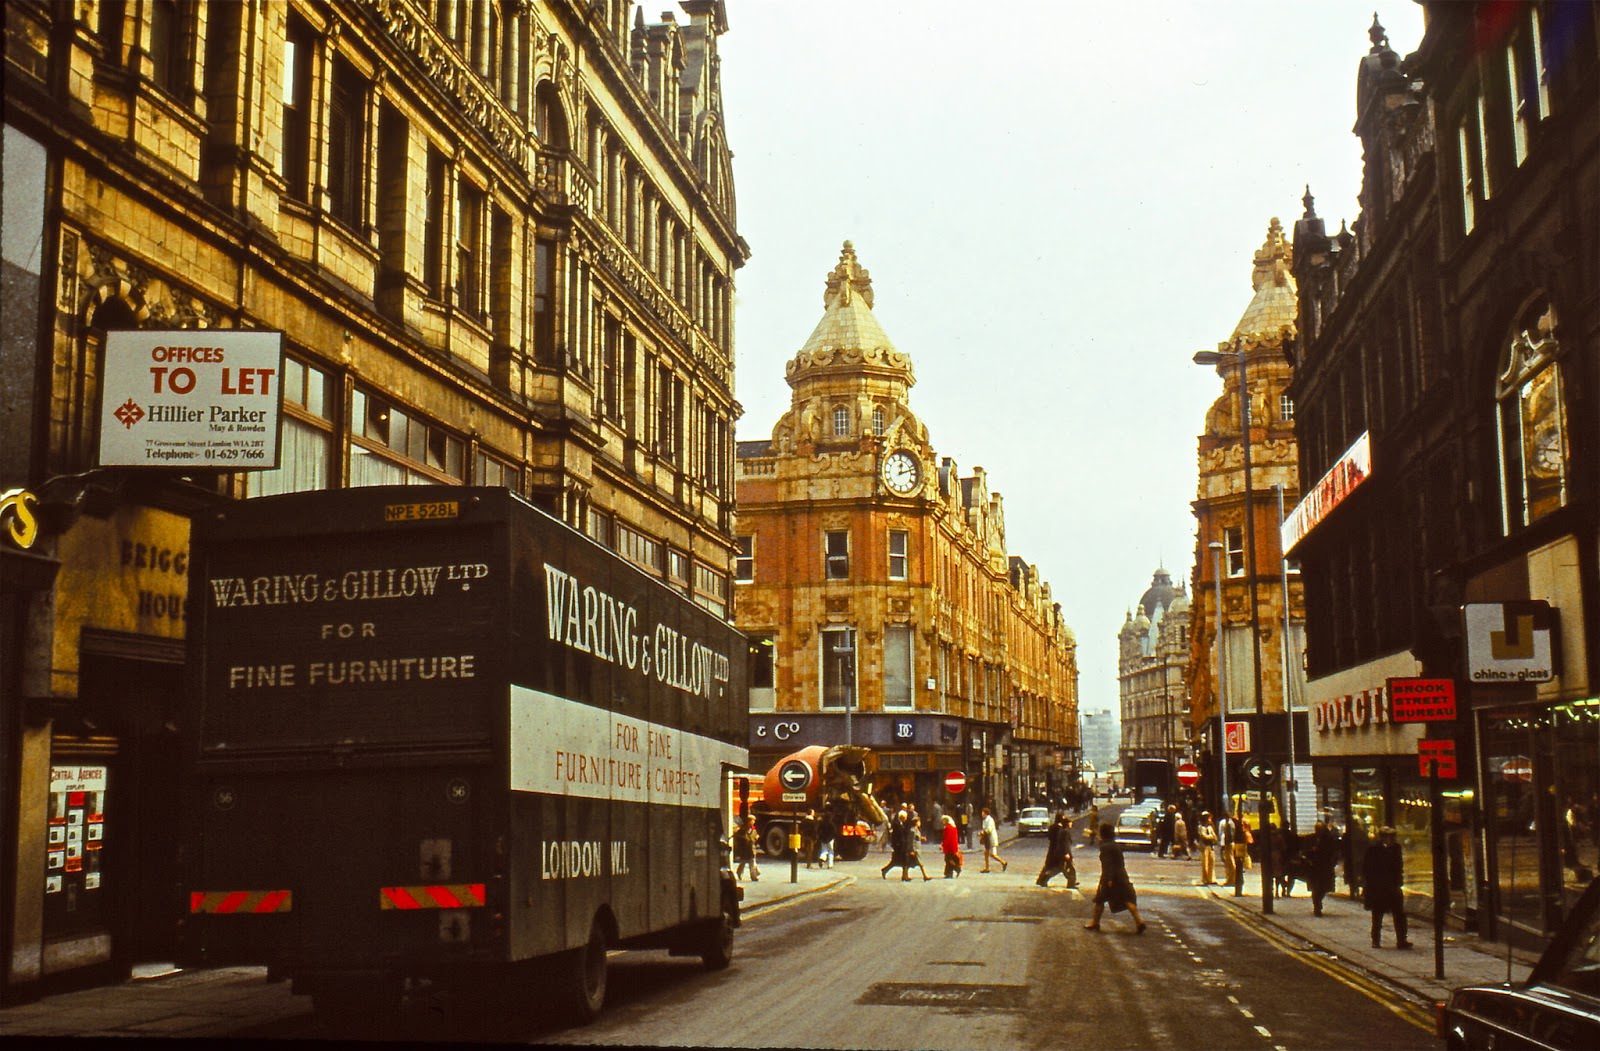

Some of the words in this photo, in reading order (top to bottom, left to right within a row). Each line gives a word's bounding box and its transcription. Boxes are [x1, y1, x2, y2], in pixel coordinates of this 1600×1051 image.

[152, 346, 224, 363] OFFICES
[150, 367, 197, 395] TO
[221, 368, 275, 395] LET
[148, 405, 204, 422] Hillier
[209, 406, 267, 423] Parker
[209, 424, 225, 432] May
[228, 424, 234, 432] &
[205, 449, 238, 459] 01-629
[241, 449, 265, 459] 7666
[386, 505, 414, 520] NPE
[419, 504, 457, 518] 528L
[210, 573, 319, 607] WARING
[323, 579, 339, 601] &
[342, 565, 443, 601] GILLOW
[321, 622, 376, 640] FOR
[543, 562, 638, 670] WARING
[641, 635, 651, 675] &
[655, 623, 713, 699] GILLOW
[230, 664, 296, 689] FINE
[309, 655, 476, 686] FURNITURE
[1395, 696, 1449, 705] STREET
[1396, 708, 1454, 717] BUREAU
[616, 723, 639, 753] FOR
[648, 730, 673, 760] FINE
[556, 751, 641, 790] FURNITURE
[655, 768, 701, 796] CARPETS
[542, 840, 601, 880] LONDON
